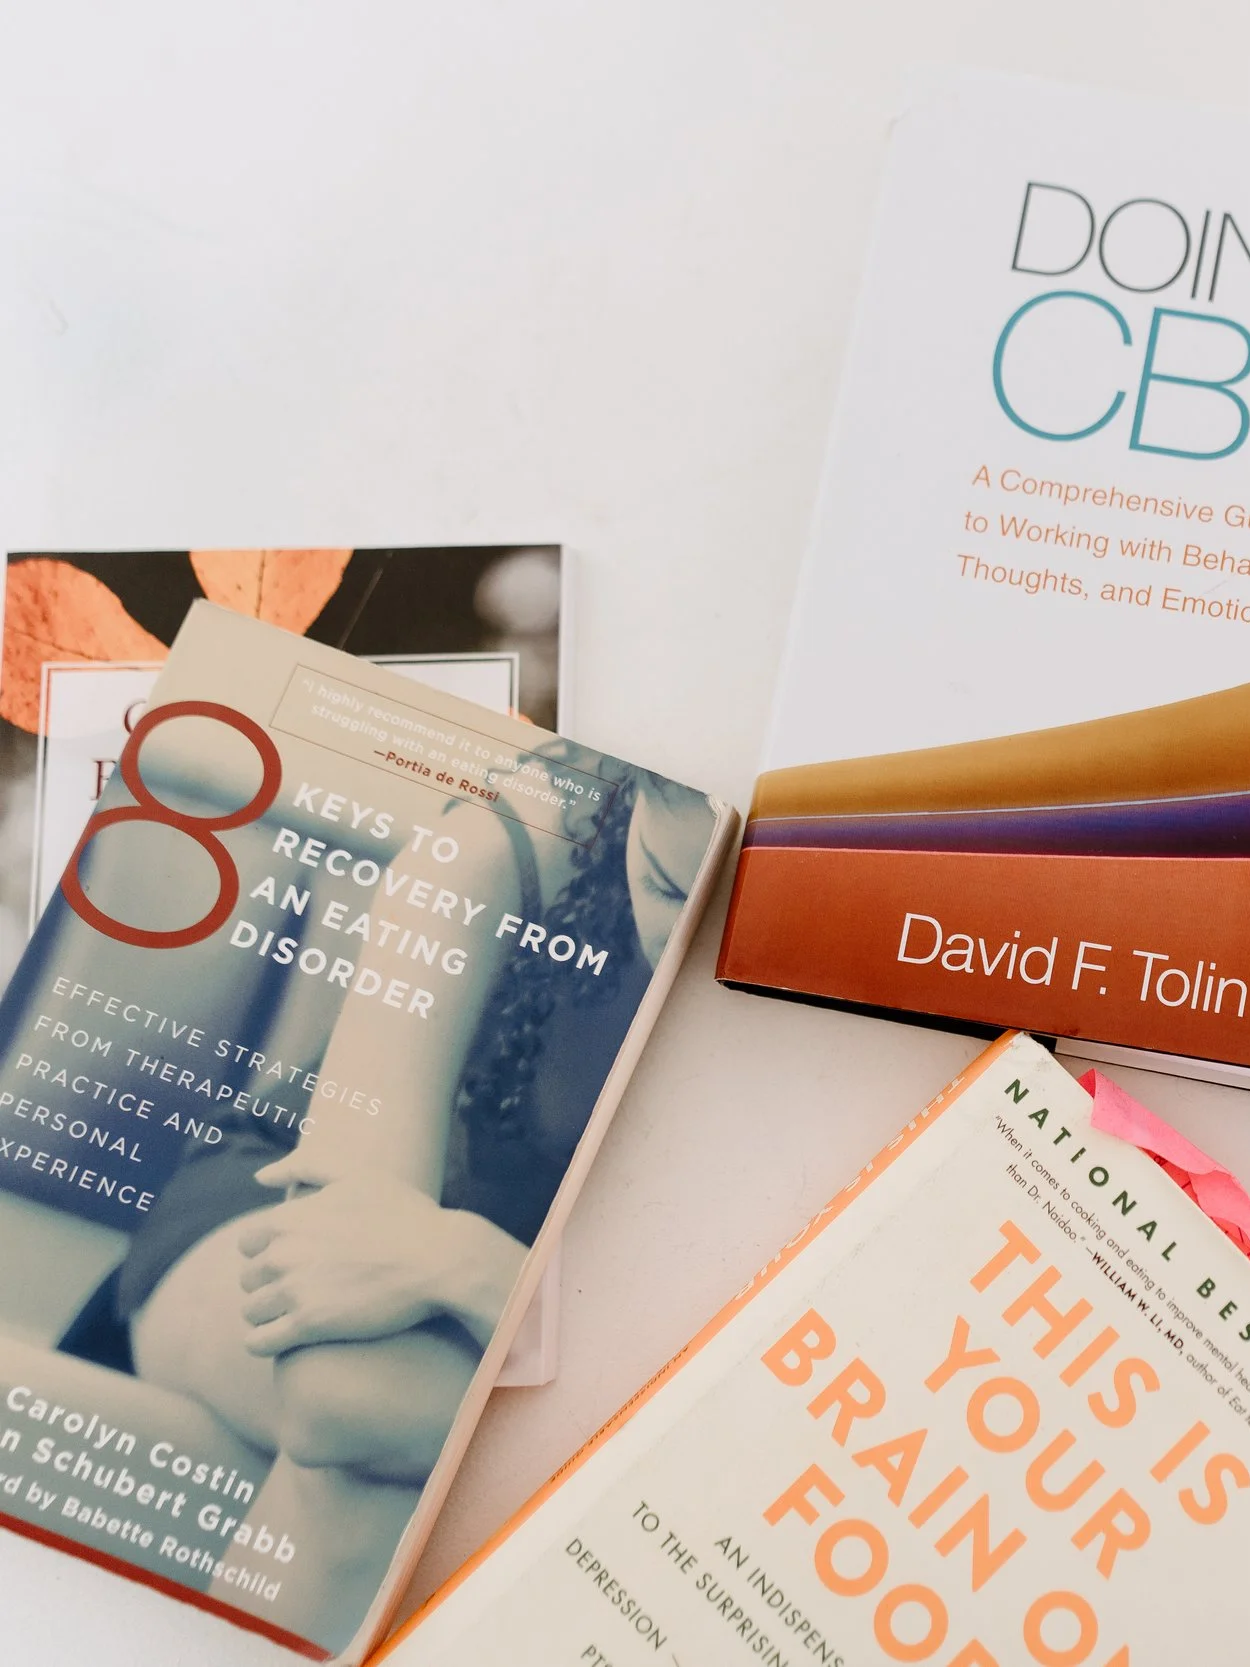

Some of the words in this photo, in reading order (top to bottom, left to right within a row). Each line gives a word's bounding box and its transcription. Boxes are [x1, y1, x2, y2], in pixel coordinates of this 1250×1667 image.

[964, 511, 989, 534] to
[1000, 514, 1110, 558] Working
[1119, 537, 1173, 564] with
[971, 464, 991, 488] A
[1000, 469, 1214, 523] Comprehensive
[957, 553, 1089, 600] Thoughts,
[1100, 581, 1153, 607] and
[311, 703, 388, 743] struggling
[392, 732, 425, 755] with
[428, 748, 446, 764] an
[450, 756, 499, 785] eating
[503, 775, 577, 810] disorder.”
[318, 685, 363, 714] highly
[367, 703, 457, 746] recommend
[459, 736, 471, 751] it
[475, 743, 491, 760] to
[494, 753, 549, 782] anyone
[553, 774, 584, 796] who
[588, 786, 601, 802] is
[435, 768, 455, 786] de
[459, 778, 500, 803] Rossi
[62, 701, 282, 949] 8
[292, 782, 396, 841] KEYS
[410, 824, 460, 864] TO
[249, 875, 312, 916] AN
[320, 900, 468, 977] EATING
[271, 827, 487, 927] RECOVERY
[494, 912, 609, 977] FROM
[229, 919, 436, 1020] DISORDER
[897, 911, 1058, 988] David
[1071, 940, 1112, 996] F.
[1131, 949, 1248, 1019] Tolin
[16, 1053, 155, 1120] PRACTICE
[163, 1111, 223, 1146] AND
[34, 1015, 113, 1058] FROM
[126, 1048, 317, 1137] THERAPEUTIC
[52, 976, 206, 1048] EFFECTIVE
[214, 1039, 383, 1117] STRATEGIES
[0, 1092, 142, 1163] PERSONAL
[0, 1137, 155, 1212] XPERIENCE
[1004, 1078, 1178, 1262] NATIONAL
[1006, 1163, 1027, 1187] than
[1026, 1184, 1042, 1204] Dr.
[1137, 1298, 1152, 1316] W.
[1149, 1312, 1164, 1333] LI,
[1163, 1328, 1185, 1355] MD,
[1185, 1352, 1219, 1387] author
[1216, 1383, 1231, 1400] of
[1228, 1395, 1248, 1416] Eat
[1022, 1146, 1034, 1162] it
[1031, 1160, 1061, 1191] comes
[1059, 1186, 1071, 1201] to
[1071, 1198, 1107, 1241] cooking
[1106, 1235, 1129, 1261] and
[1126, 1255, 1156, 1291] eating
[1155, 1284, 1167, 1300] to
[1166, 1298, 1203, 1339] improve
[1203, 1335, 1237, 1370] mental
[969, 1219, 1160, 1429] THIS
[7, 1386, 137, 1456] Carolyn
[149, 1442, 256, 1504] Costin
[32, 1437, 186, 1518] Schubert
[197, 1504, 296, 1564] Grabb
[760, 1307, 1028, 1593] BRAIN
[1022, 1590, 1130, 1667] O
[924, 1314, 1151, 1580] YOUR
[25, 1481, 57, 1512] by
[61, 1496, 154, 1549] Babette
[159, 1535, 283, 1603] Rothschild
[632, 1500, 660, 1533] TO
[659, 1531, 698, 1574] THE
[713, 1535, 751, 1570] AN
[565, 1537, 668, 1652] DEPRESSION
[581, 1643, 613, 1667] PT
